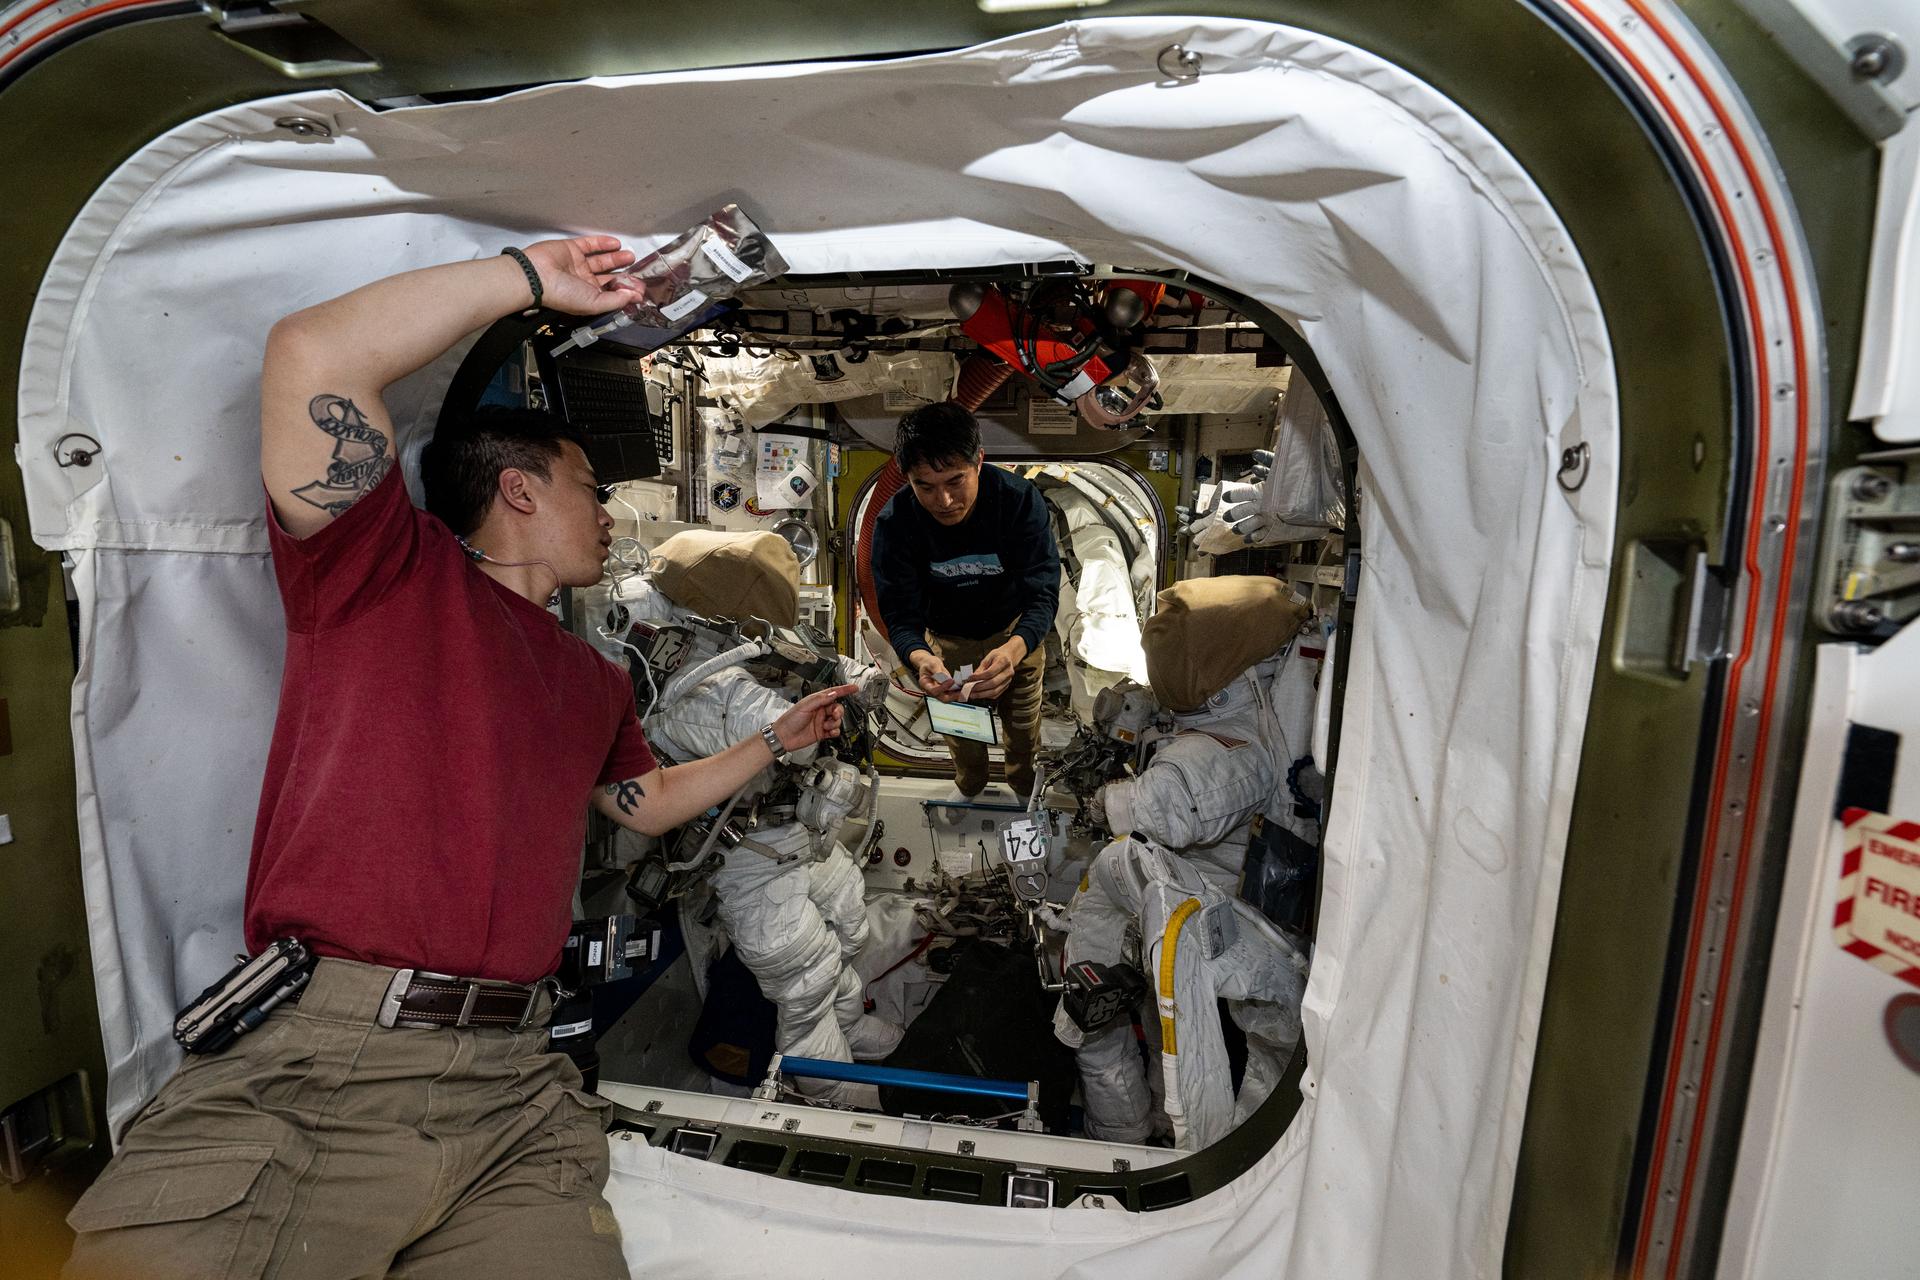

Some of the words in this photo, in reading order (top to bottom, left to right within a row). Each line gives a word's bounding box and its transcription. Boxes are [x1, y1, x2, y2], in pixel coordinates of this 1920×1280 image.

[650, 637, 683, 670] 2.7
[1007, 827, 1042, 860] 2.4
[1865, 877, 1920, 919] FIRE
